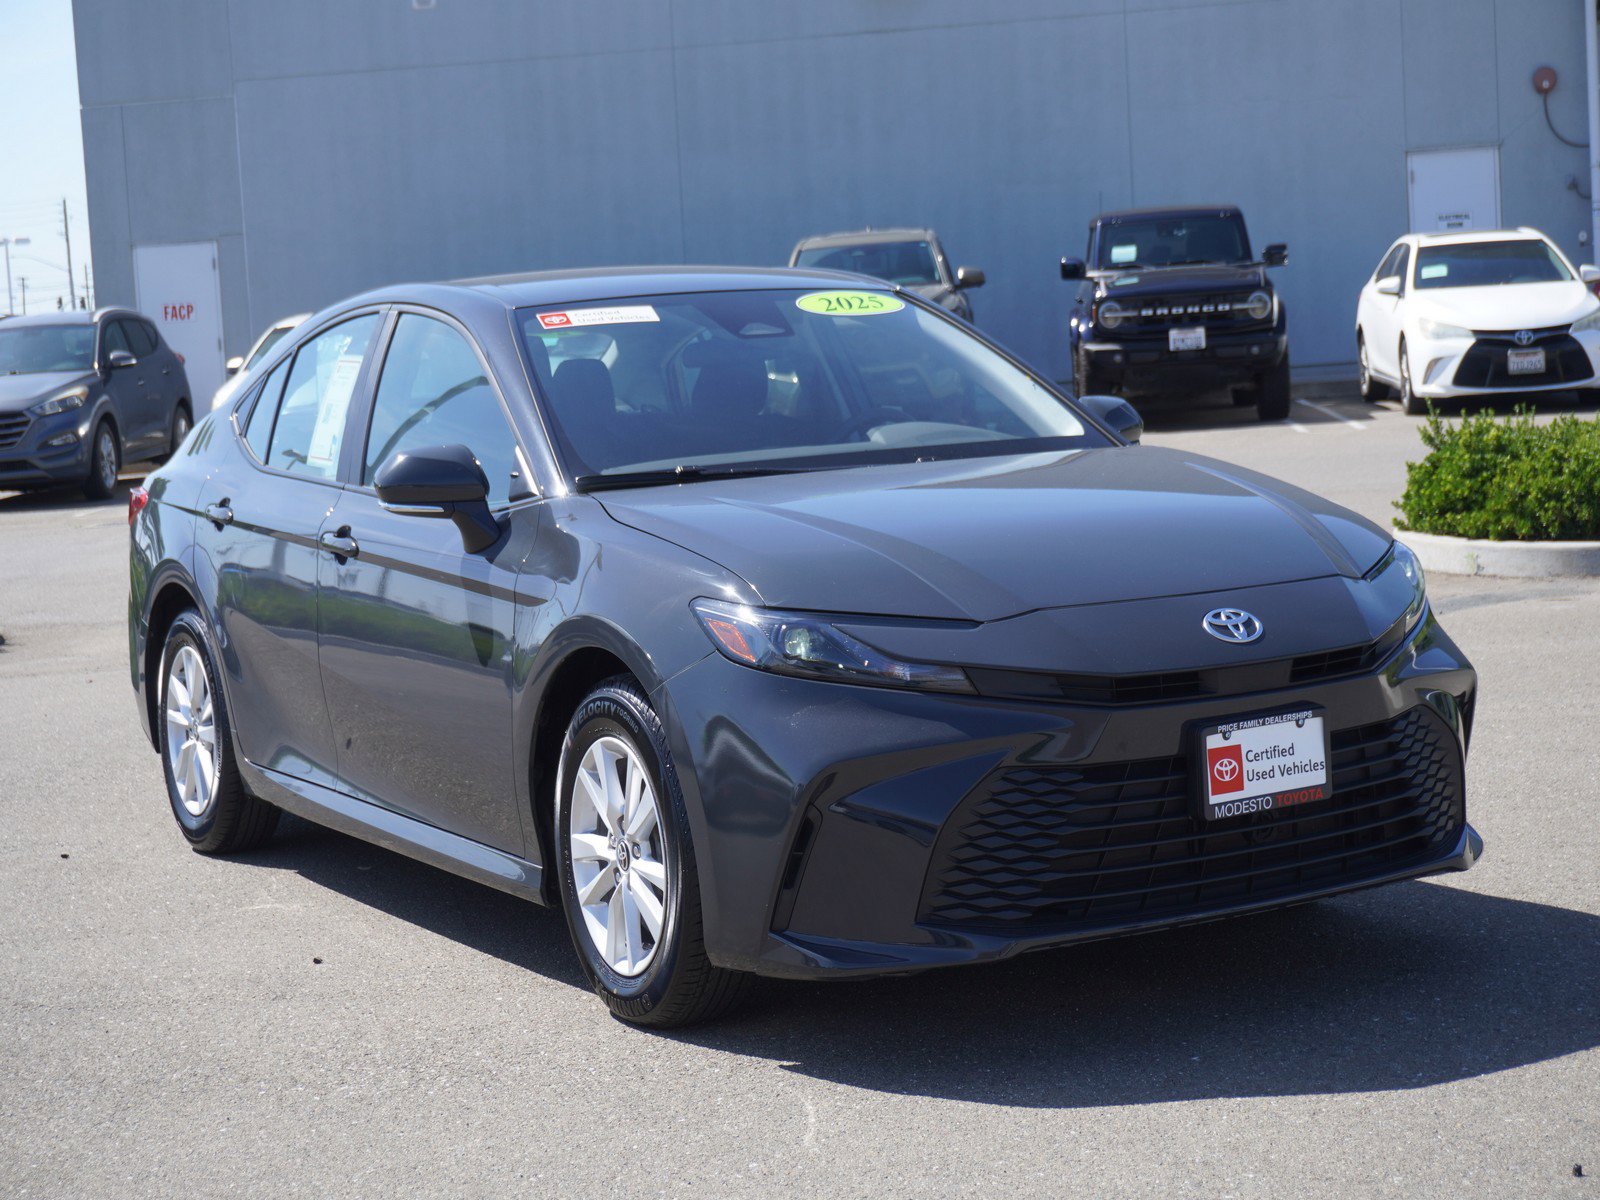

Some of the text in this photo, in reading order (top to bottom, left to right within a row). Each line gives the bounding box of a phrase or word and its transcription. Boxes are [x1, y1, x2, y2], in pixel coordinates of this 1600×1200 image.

[163, 304, 194, 321] FACP
[818, 295, 884, 312] 2025
[1141, 303, 1230, 316] BRONCO
[574, 701, 617, 729] VELOCITY
[1218, 710, 1313, 733] PRICE FAMILY DEALERSHIPS
[1245, 742, 1295, 763] Certified
[1247, 759, 1325, 782] Used Vehicles
[1215, 787, 1323, 819] MODESTO TOYOTA
